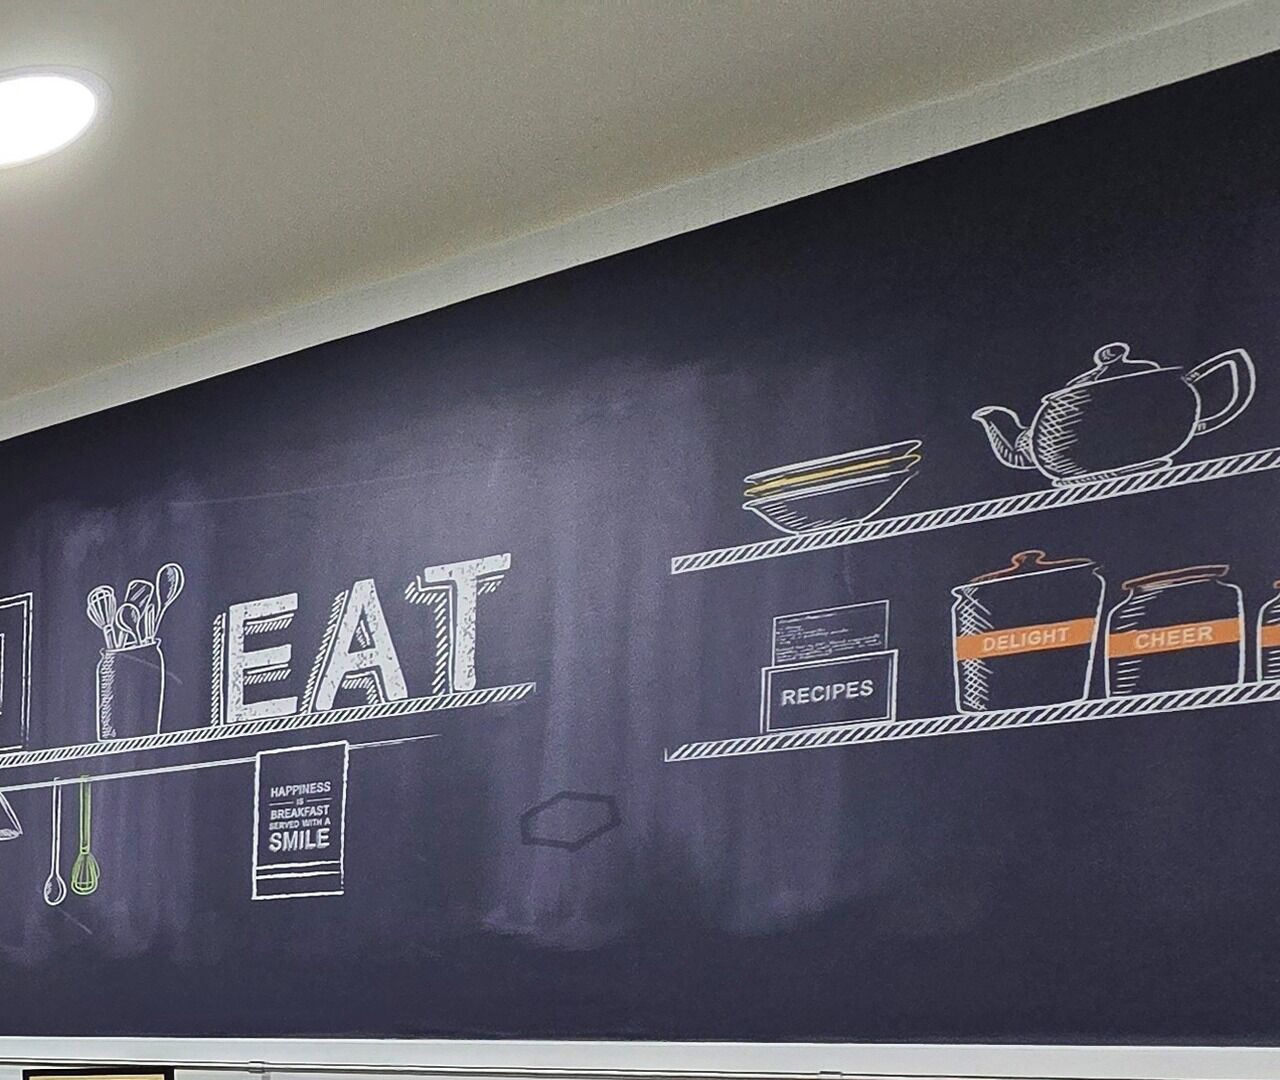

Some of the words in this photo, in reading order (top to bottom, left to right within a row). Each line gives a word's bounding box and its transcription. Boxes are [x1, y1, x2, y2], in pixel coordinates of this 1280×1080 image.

[211, 552, 512, 726] EAT
[982, 626, 1071, 652] DELIGHT
[1135, 625, 1214, 650] CHEER
[781, 679, 874, 706] RECIPES
[270, 781, 331, 798] HAPPINESS
[296, 797, 305, 805] IS
[268, 820, 300, 830] SERVED
[301, 818, 322, 828] WITH
[324, 816, 331, 825] A
[270, 804, 330, 820] BREAKFAST
[268, 827, 330, 852] SMILE
